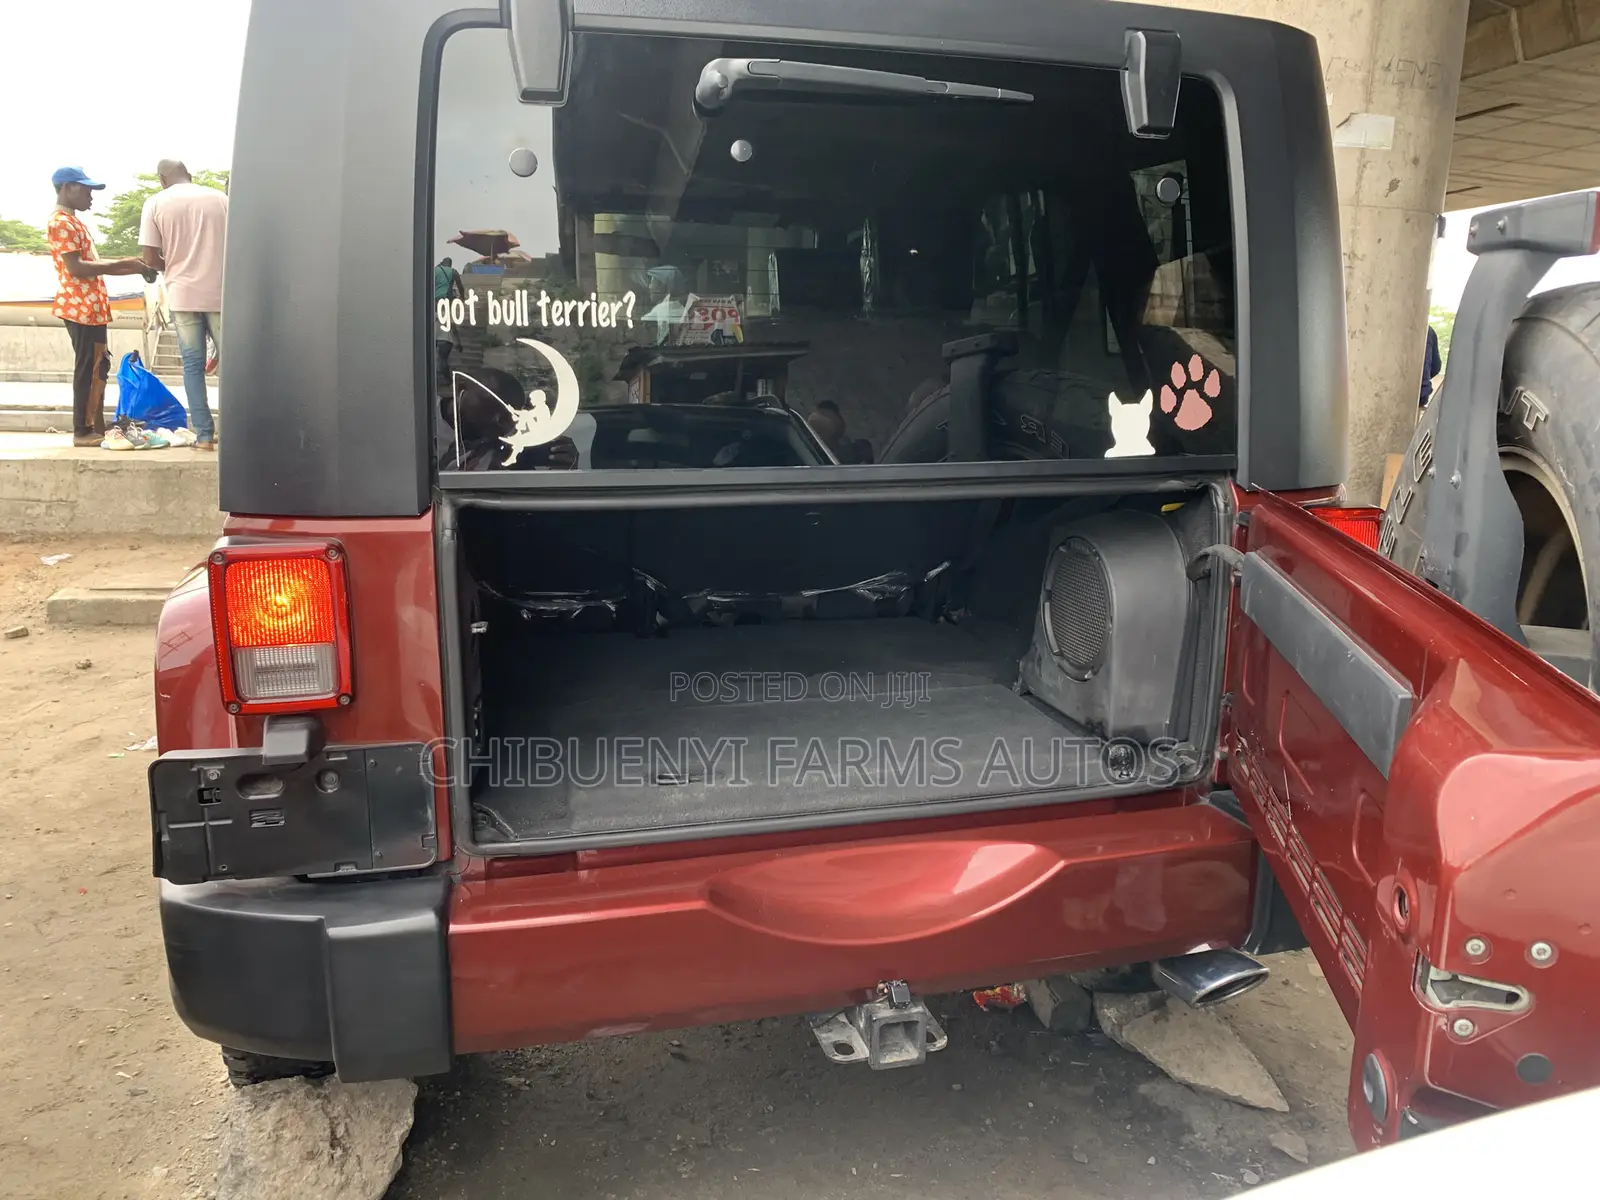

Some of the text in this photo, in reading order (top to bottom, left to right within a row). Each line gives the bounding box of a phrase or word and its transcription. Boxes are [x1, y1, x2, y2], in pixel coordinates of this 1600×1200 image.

[437, 289, 636, 332] got bull terrier?
